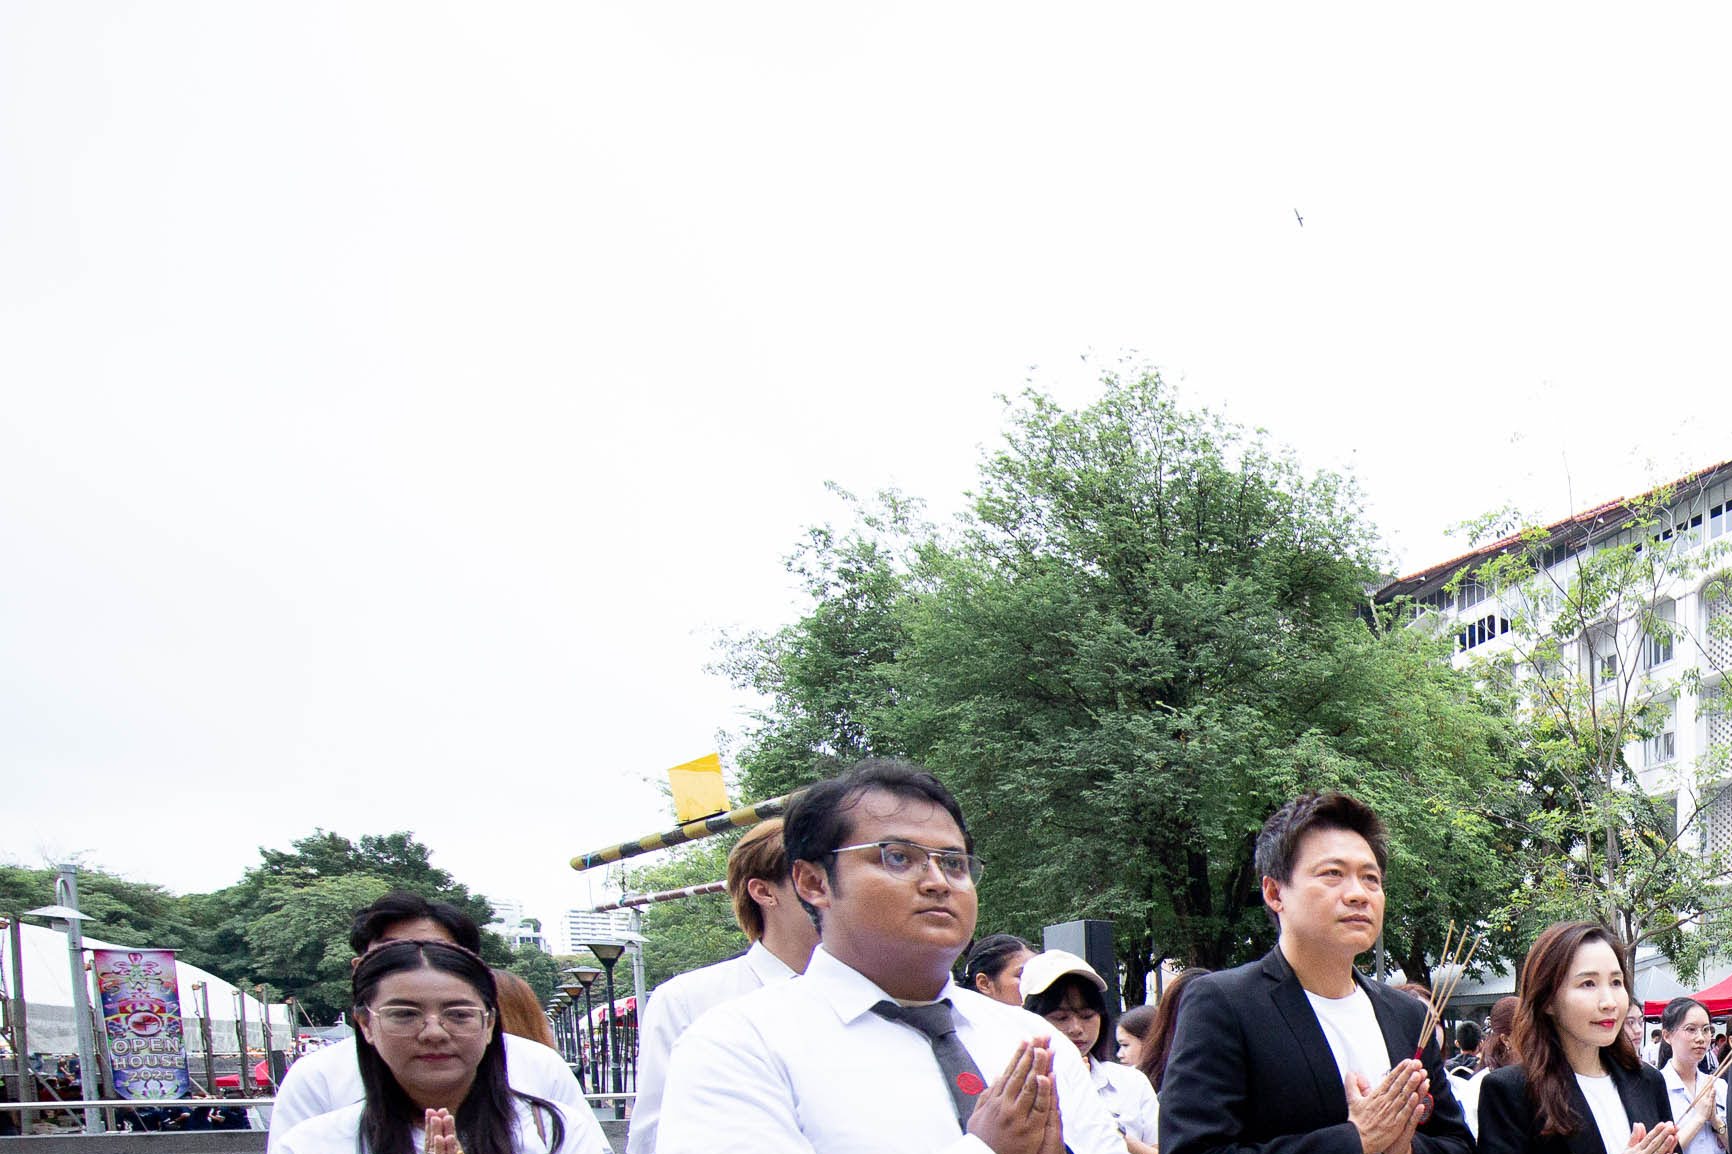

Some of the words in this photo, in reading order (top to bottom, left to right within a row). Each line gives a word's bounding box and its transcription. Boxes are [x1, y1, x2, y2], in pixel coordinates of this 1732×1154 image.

[113, 1038, 181, 1054] OPEN
[114, 1055, 185, 1070] HOUSE
[129, 1070, 175, 1082] 2025
